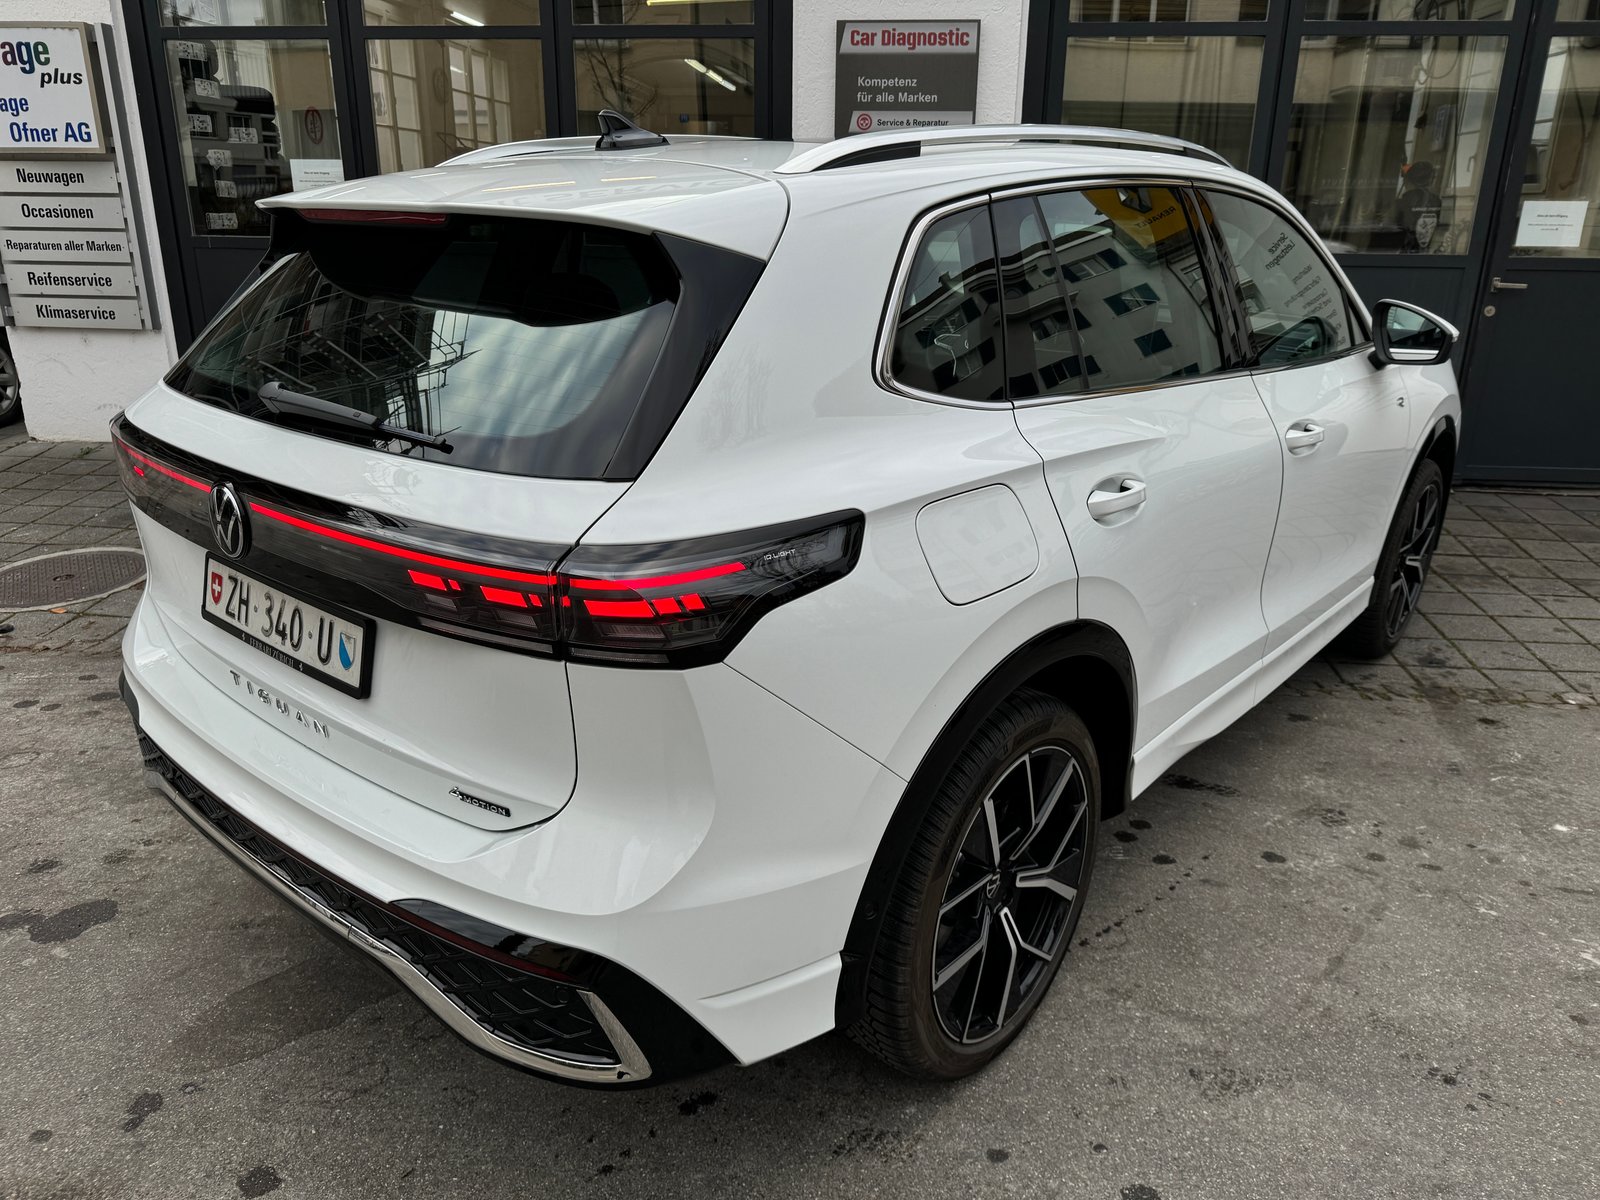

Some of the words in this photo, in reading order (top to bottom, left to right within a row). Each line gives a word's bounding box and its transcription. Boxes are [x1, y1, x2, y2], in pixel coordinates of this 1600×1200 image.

[850, 30, 877, 46] Car
[881, 28, 970, 50] Diagnostic
[40, 68, 83, 88] plus
[857, 76, 917, 89] Kompetenz
[857, 92, 873, 103] für
[876, 92, 895, 103] alle
[898, 92, 938, 103] Marken
[877, 118, 904, 127] Service
[905, 118, 911, 126] &
[912, 118, 949, 128] Reparatur
[9, 122, 58, 142] Ofner
[64, 122, 92, 142] AG
[16, 168, 85, 187] Neuwagen
[21, 203, 94, 219] Occasionen
[5, 239, 63, 252] Reparaturen
[64, 240, 84, 251] aller
[86, 241, 122, 252] Marken
[27, 271, 112, 287] Reifenservice
[36, 304, 116, 320] Klimaservice
[224, 574, 251, 627] ZH
[261, 591, 304, 651] 340
[317, 614, 335, 666] U
[229, 669, 330, 738] TIGUAN
[448, 786, 507, 816] 4MOTION
